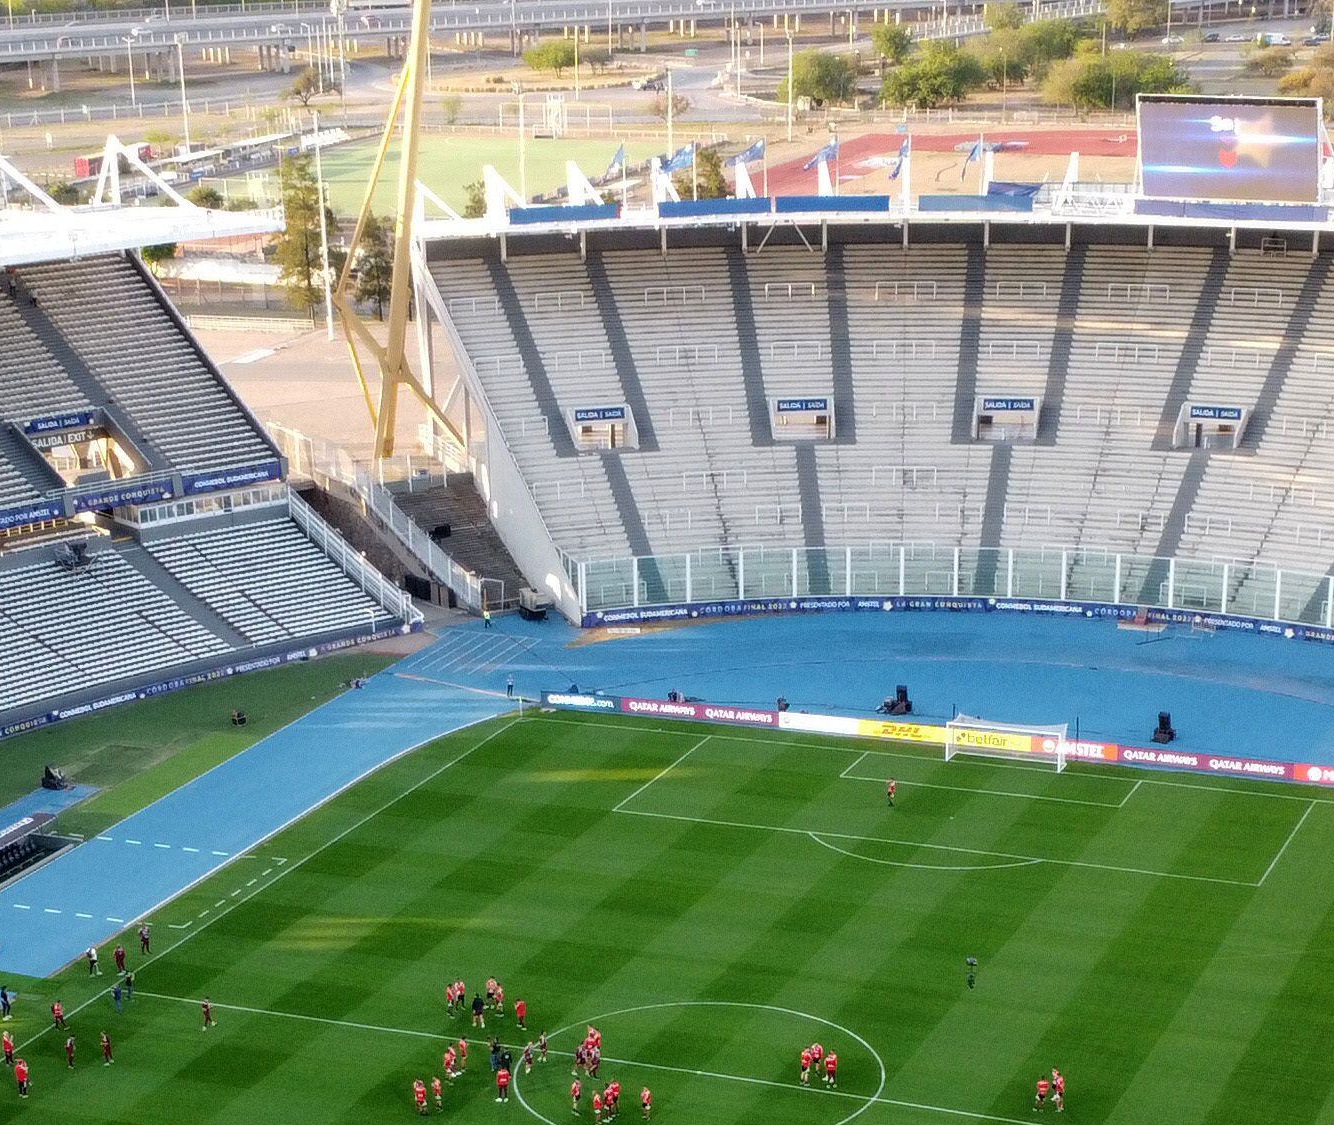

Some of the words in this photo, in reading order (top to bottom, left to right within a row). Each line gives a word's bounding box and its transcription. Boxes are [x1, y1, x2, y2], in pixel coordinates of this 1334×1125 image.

[67, 432, 86, 442] EXIT
[629, 701, 659, 713] QATAR
[659, 703, 696, 716] AIRWAYS
[705, 708, 735, 720] QATAR
[735, 710, 773, 723] AIRWAYS
[967, 733, 1008, 747] betfair
[1123, 749, 1156, 762] QATAR
[1157, 753, 1198, 766] AIRWAYS
[1209, 758, 1243, 771] QATAR
[1243, 762, 1285, 775] AIRWAYS
